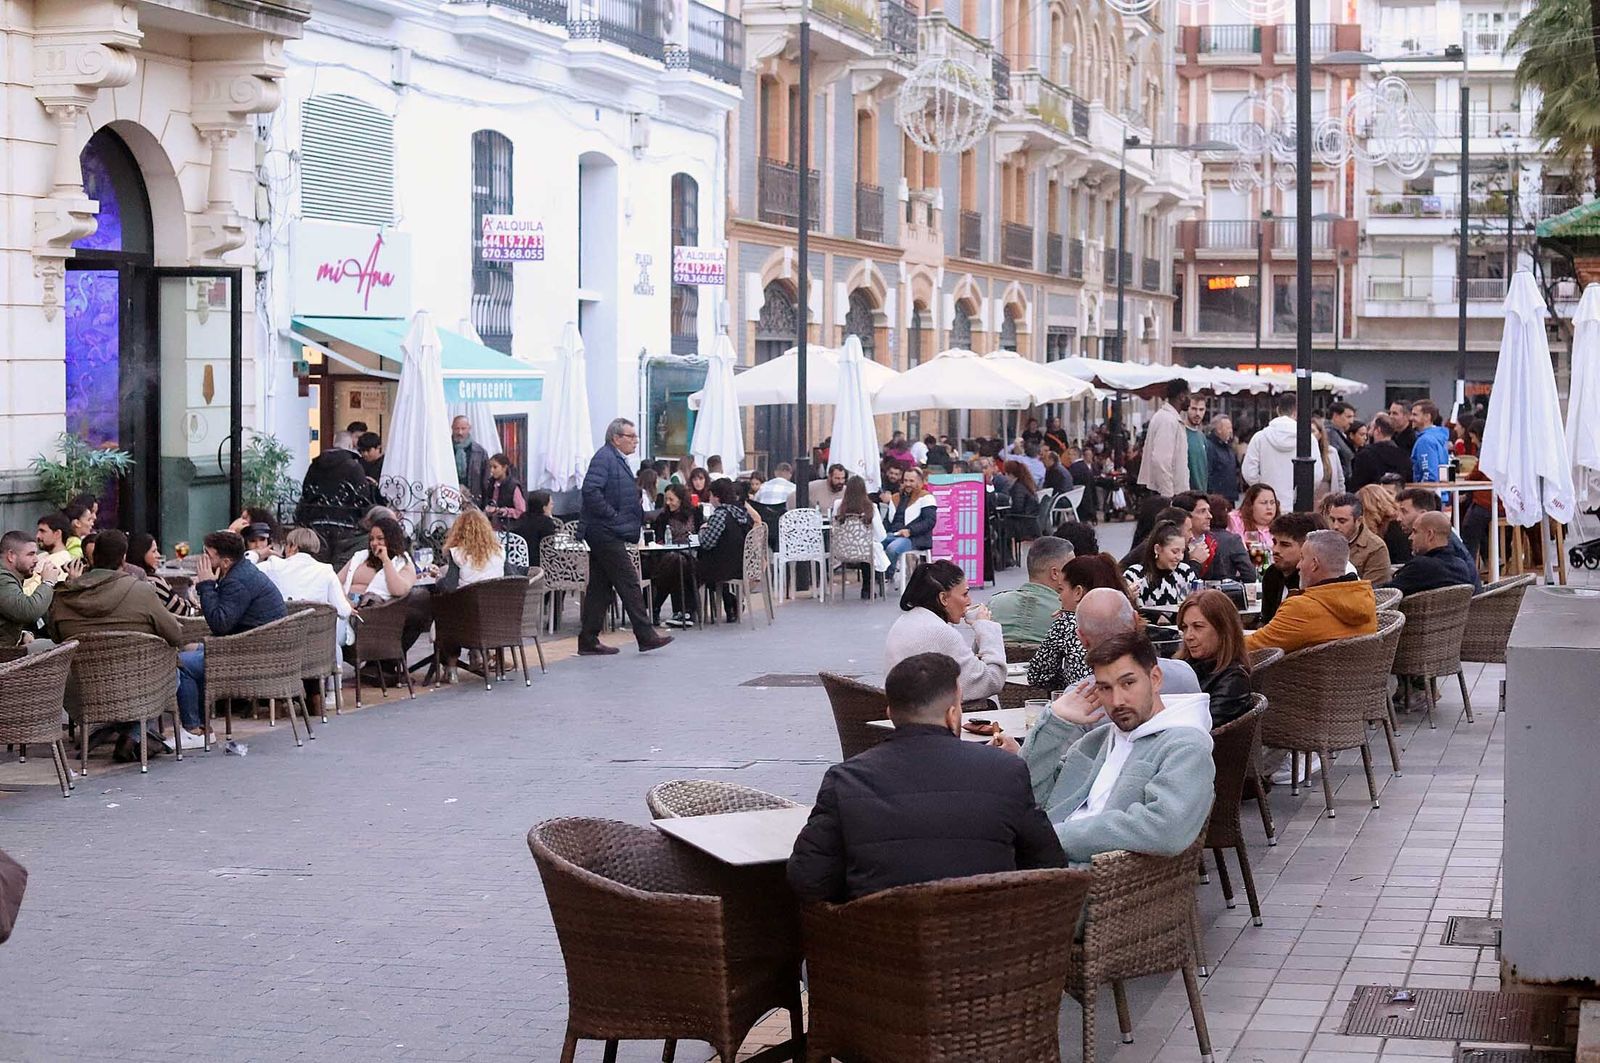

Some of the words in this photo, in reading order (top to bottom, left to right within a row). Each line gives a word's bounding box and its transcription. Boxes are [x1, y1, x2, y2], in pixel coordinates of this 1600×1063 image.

[497, 220, 543, 231] ALQUILA
[482, 248, 543, 258] 670.368.055
[687, 251, 724, 260] ALQUILA
